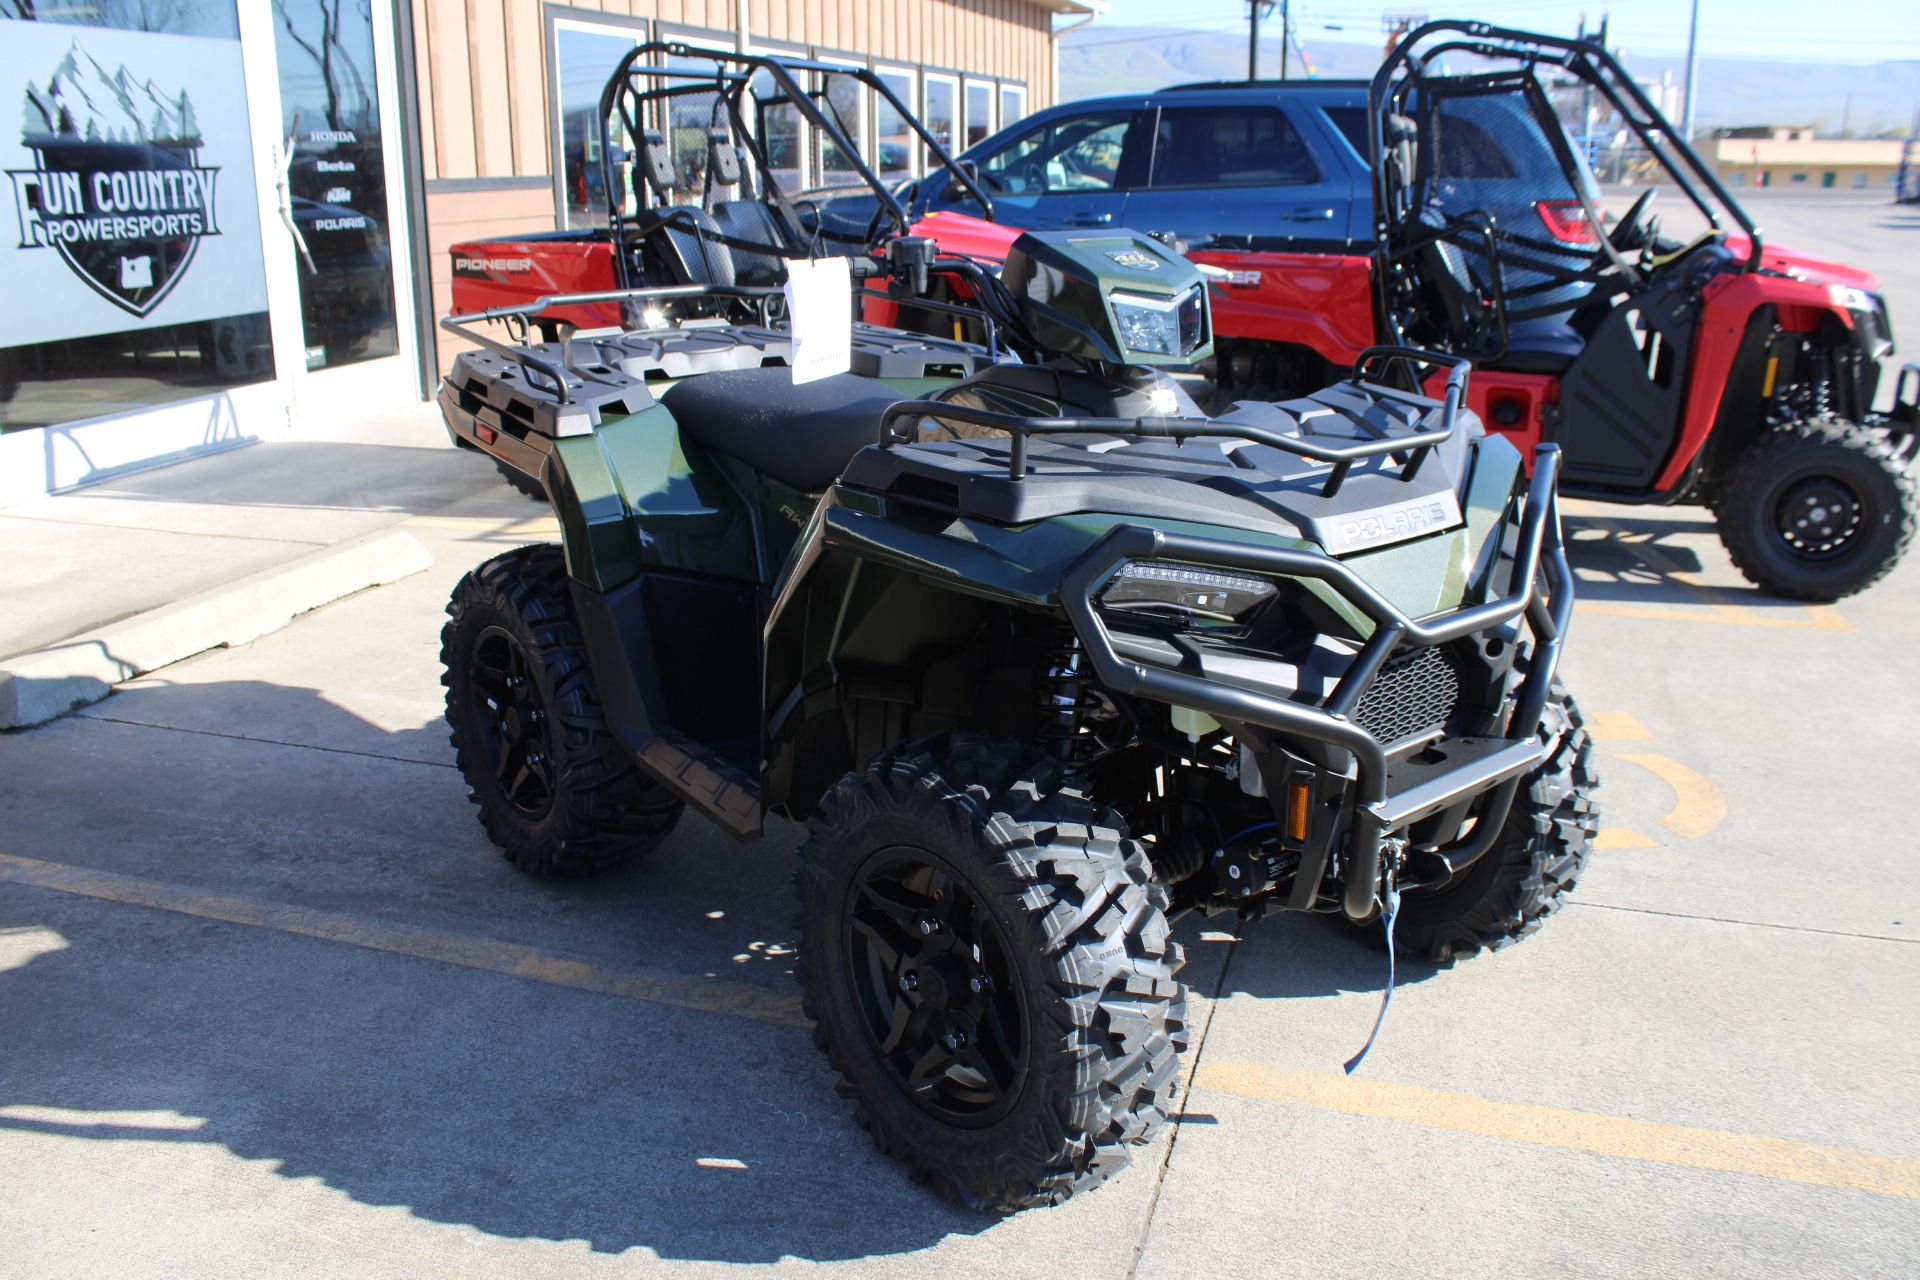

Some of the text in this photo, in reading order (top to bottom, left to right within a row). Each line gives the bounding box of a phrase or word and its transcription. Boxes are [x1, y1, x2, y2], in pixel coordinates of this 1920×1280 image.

[310, 130, 357, 143] HONDA
[316, 160, 356, 172] Beta
[326, 186, 352, 203] KTM
[11, 168, 217, 247] FUN COUNTRY
[46, 213, 202, 243] POWERSPORTS
[315, 216, 367, 232] POLARIS
[456, 258, 532, 271] PIONEER
[779, 504, 810, 529] AW
[1341, 502, 1447, 544] POLARIS
[1099, 946, 1123, 960] DURO
